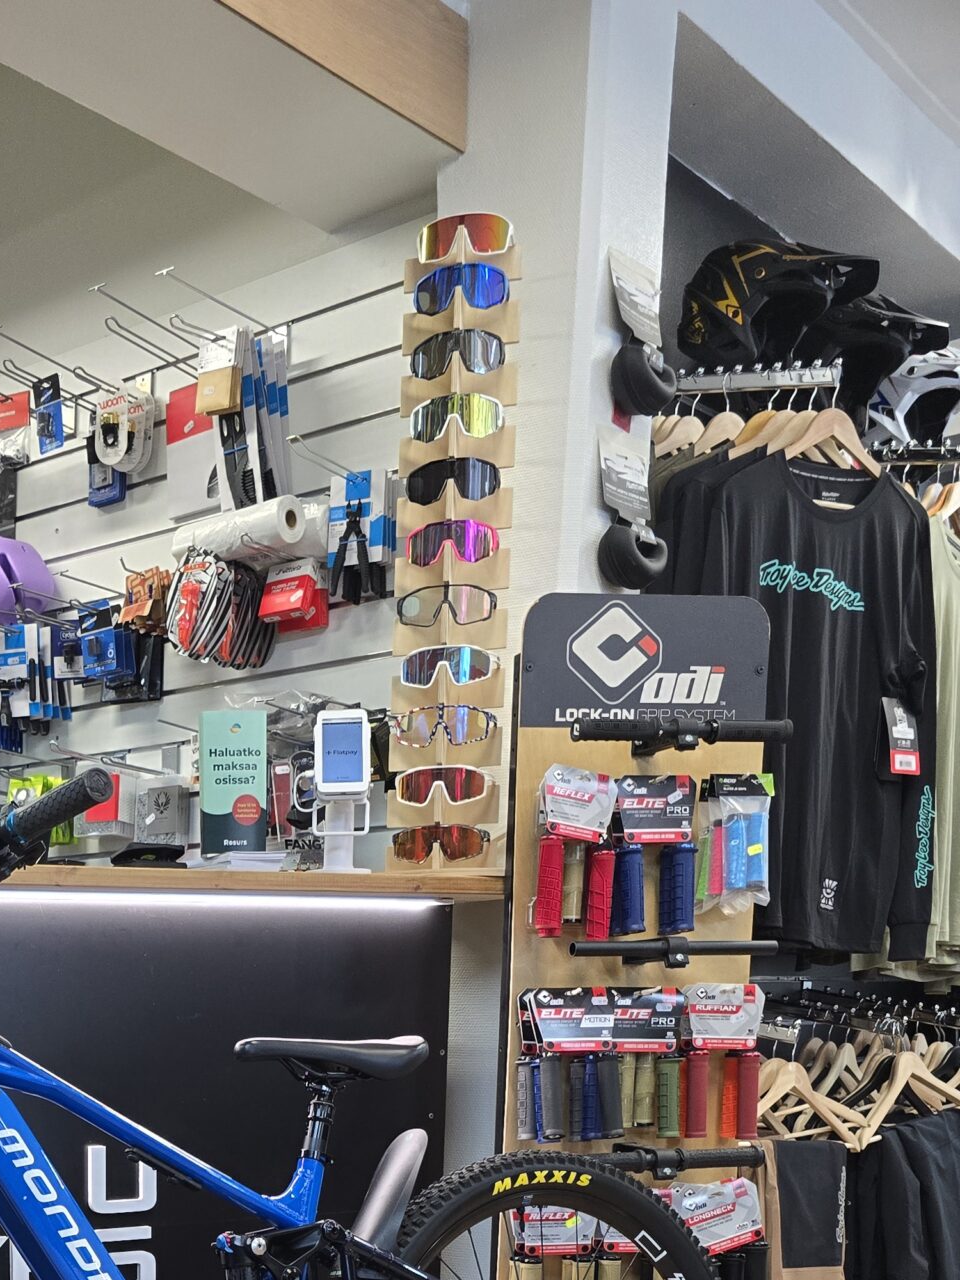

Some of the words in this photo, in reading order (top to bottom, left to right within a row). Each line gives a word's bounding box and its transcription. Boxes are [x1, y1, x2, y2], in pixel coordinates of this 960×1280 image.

[98, 395, 127, 410] woom
[128, 404, 144, 415] om
[640, 666, 726, 704] odi
[555, 708, 635, 722] LOCK-ON
[209, 748, 261, 758] Haluatko
[213, 761, 258, 771] maksaa
[214, 775, 256, 785] osissa?
[553, 786, 591, 801] REFLEX
[623, 798, 666, 809] ELITE
[666, 806, 690, 815] PRO
[695, 1004, 737, 1012] RUFFIAN
[540, 1009, 585, 1019] ELITE
[651, 1017, 675, 1025] PRO
[492, 1170, 592, 1196] MAXXIS
[688, 1203, 734, 1224] LONGNECK
